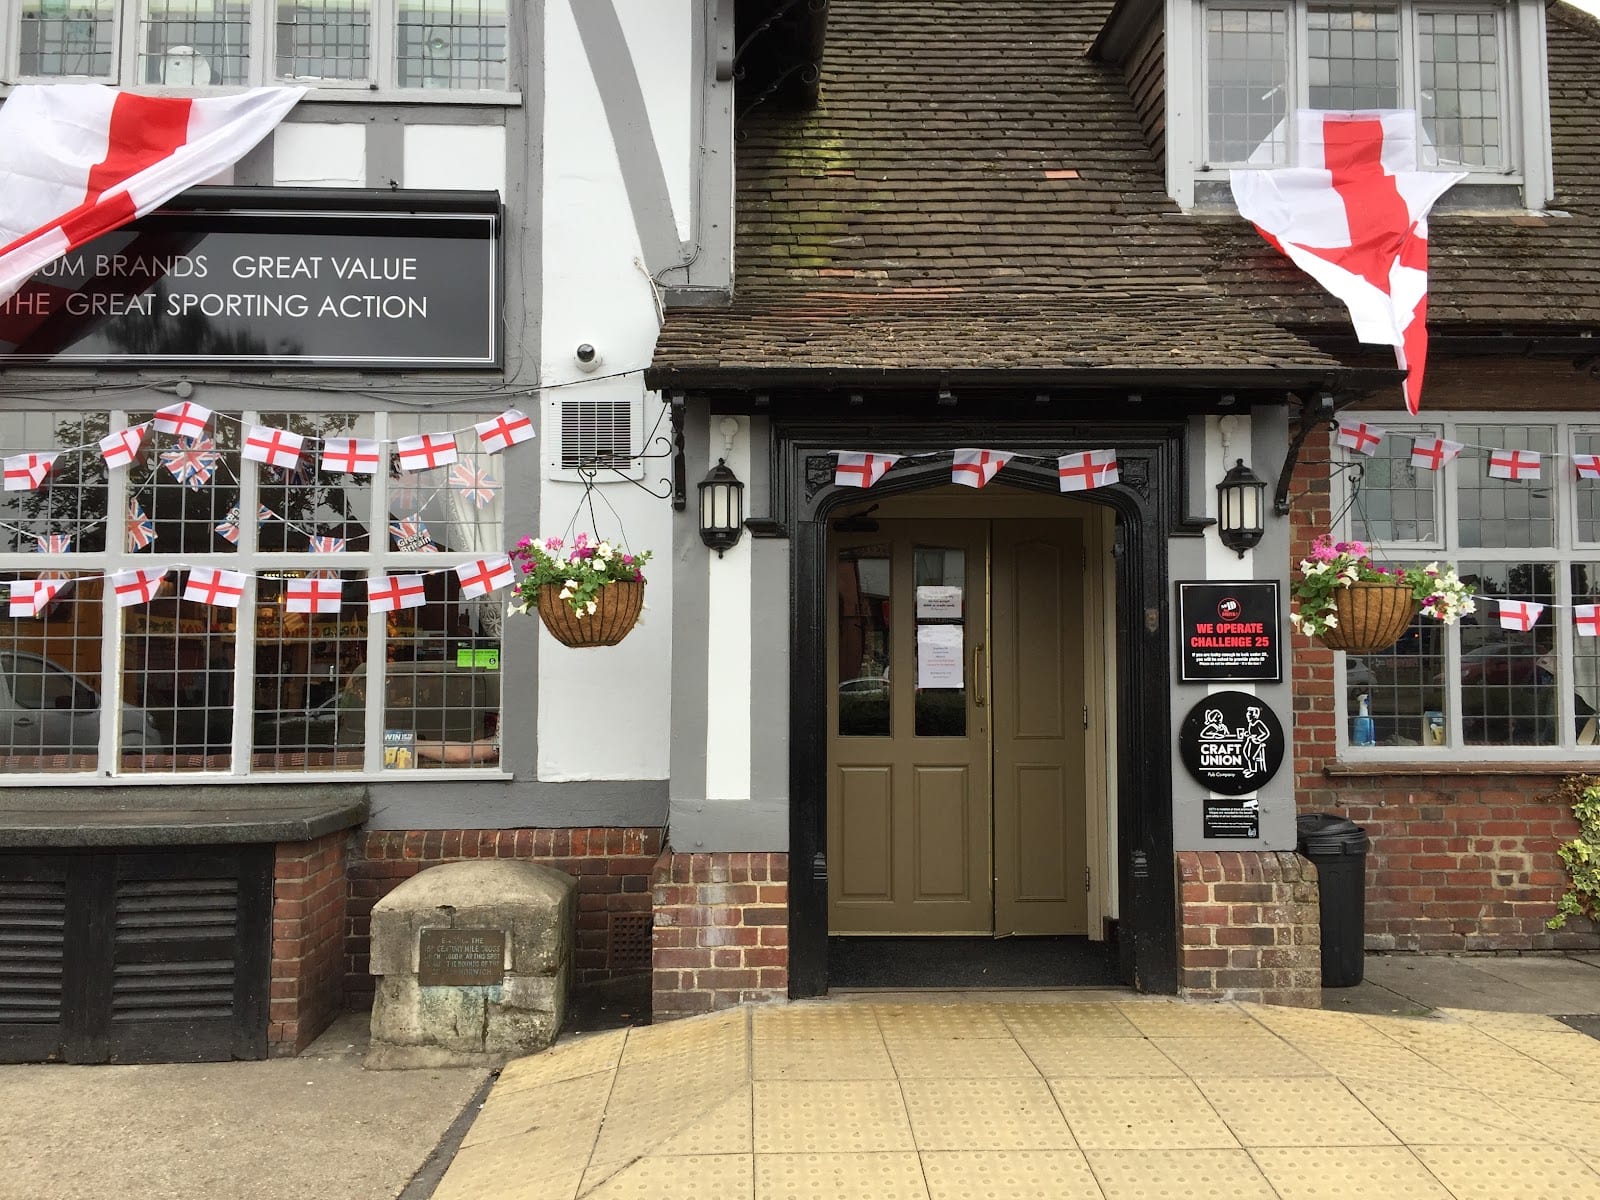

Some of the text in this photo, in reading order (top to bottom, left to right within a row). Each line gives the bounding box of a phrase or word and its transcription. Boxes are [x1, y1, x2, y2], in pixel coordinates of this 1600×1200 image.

[95, 254, 208, 278] BRANDS
[232, 255, 323, 279] GREAT
[330, 256, 417, 280] VALUE
[65, 292, 157, 316] GREAT
[166, 293, 310, 318] SPORTING
[317, 295, 427, 319] ACTION
[1196, 623, 1264, 634] WE OPERATE
[1190, 636, 1270, 648] CHALLENGE 25
[1200, 744, 1242, 755] CRAFT
[1200, 755, 1242, 766] UNION
